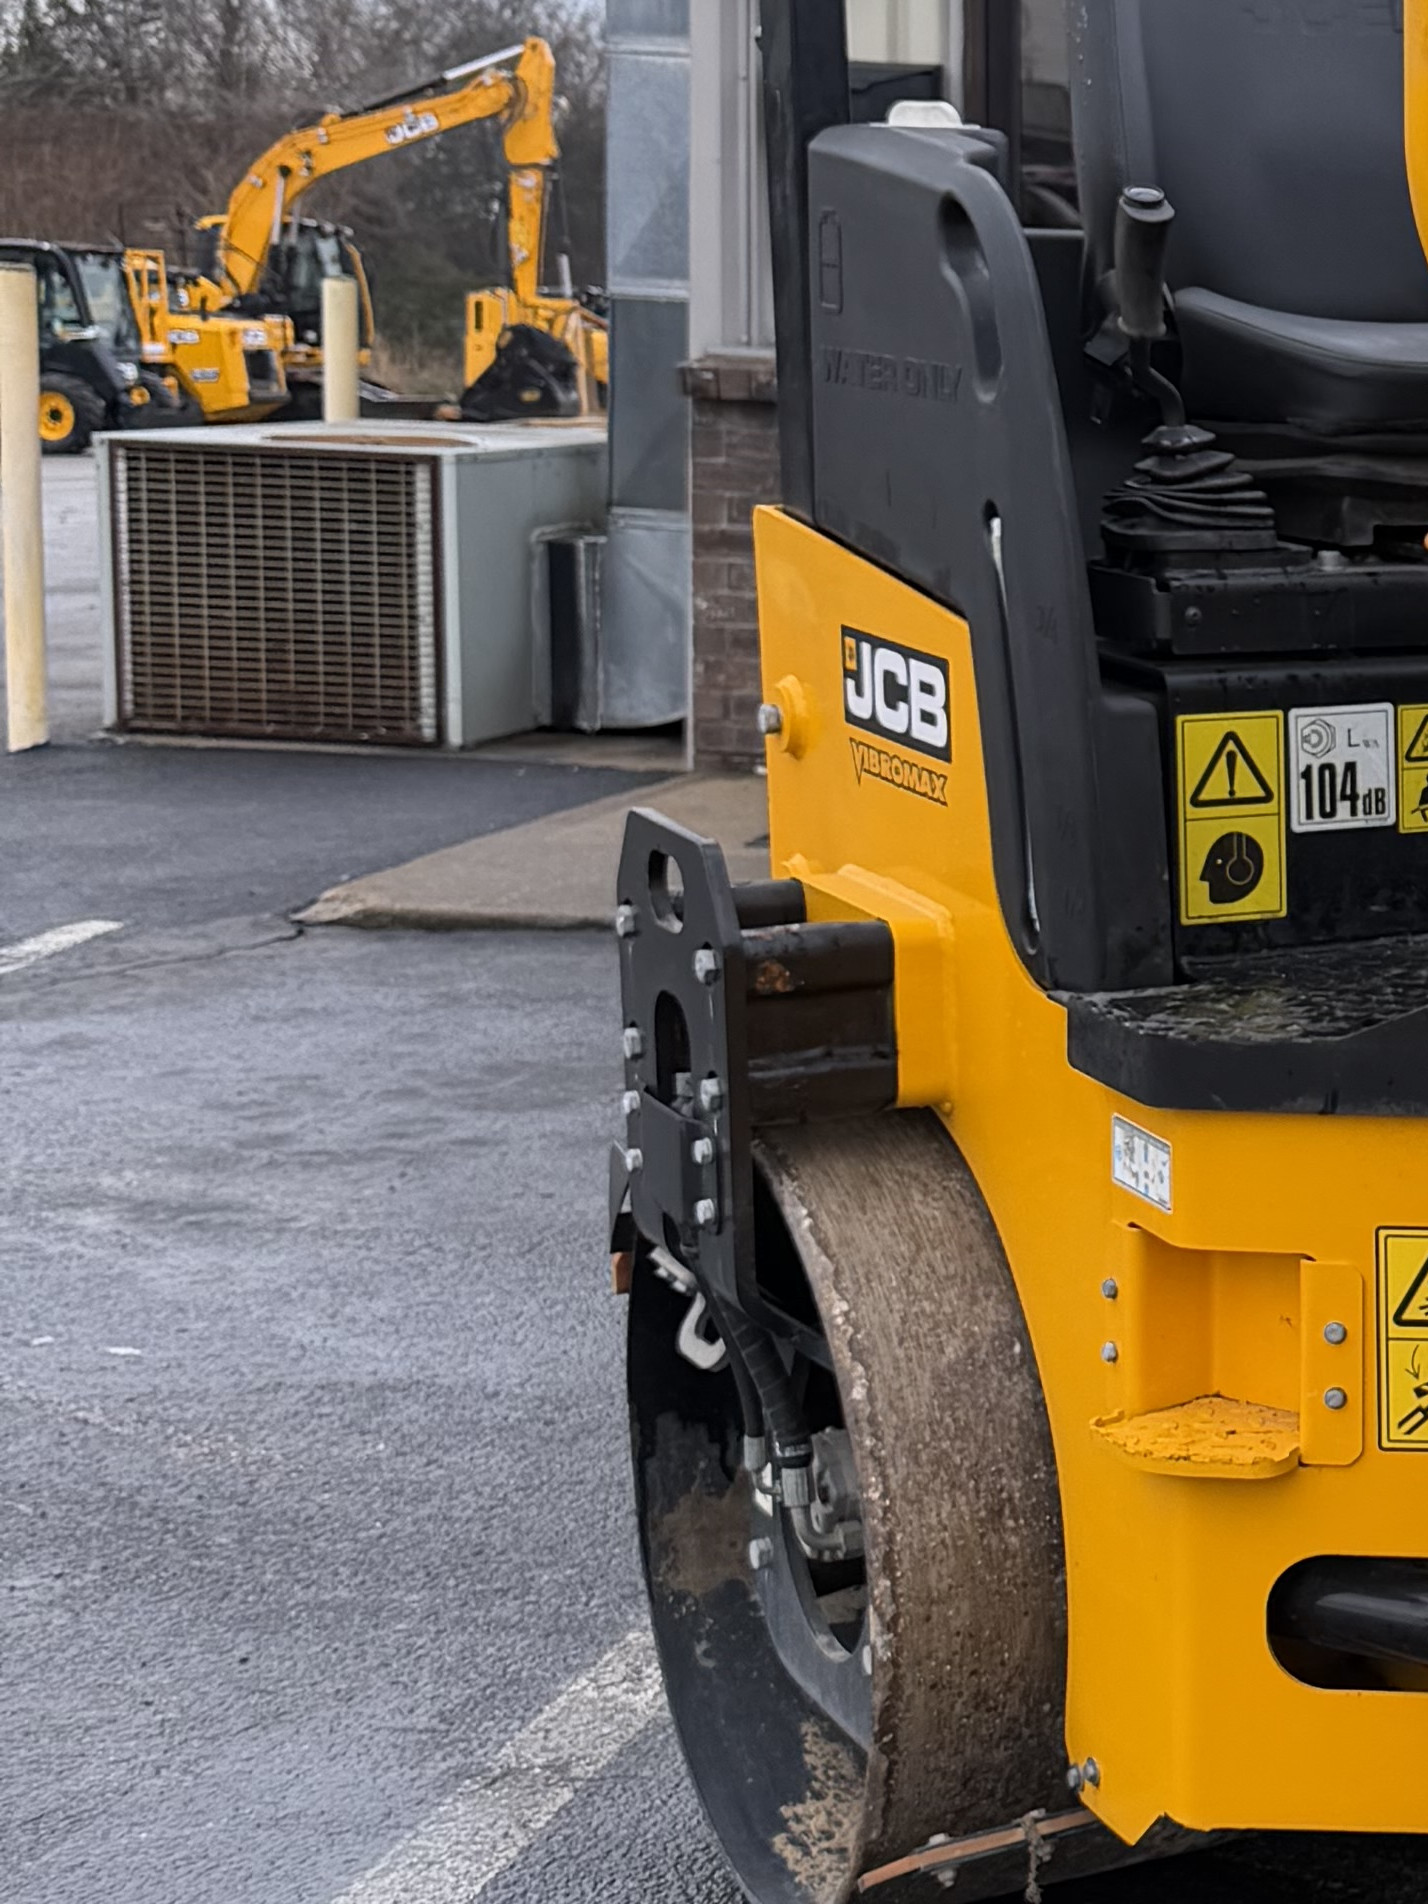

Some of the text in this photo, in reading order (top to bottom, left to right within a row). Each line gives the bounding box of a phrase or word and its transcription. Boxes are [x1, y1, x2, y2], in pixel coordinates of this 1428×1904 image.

[845, 640, 949, 748] JCB
[849, 736, 949, 807] VIBROMAX
[1300, 760, 1387, 821] 104 dB
